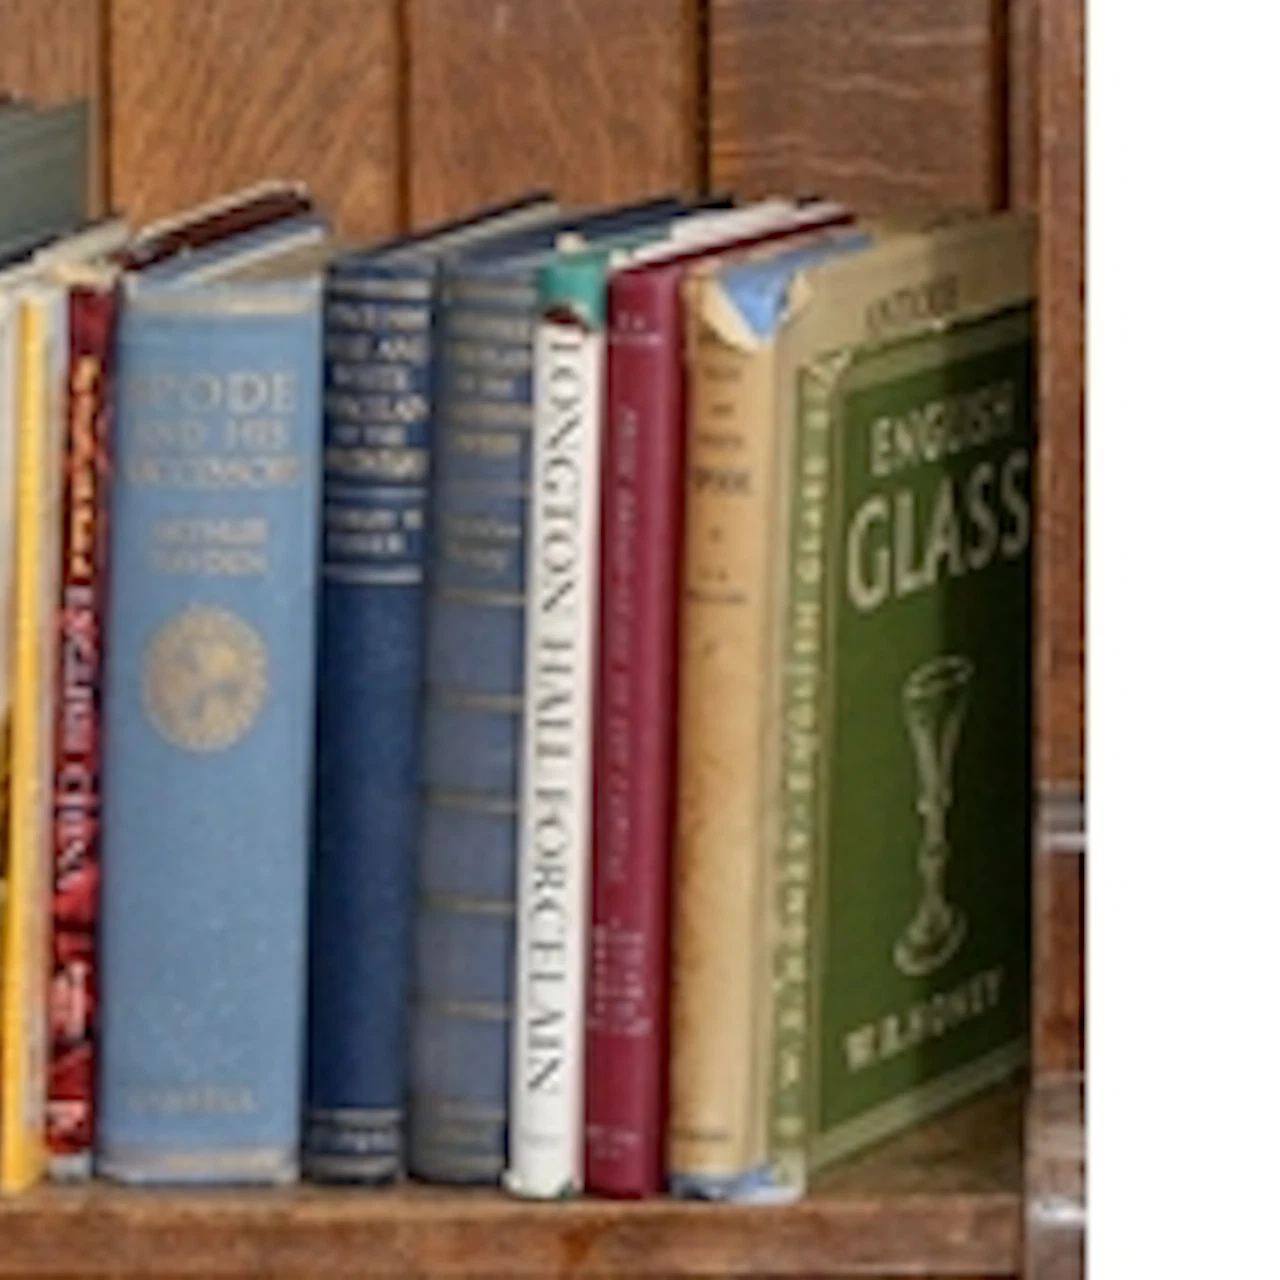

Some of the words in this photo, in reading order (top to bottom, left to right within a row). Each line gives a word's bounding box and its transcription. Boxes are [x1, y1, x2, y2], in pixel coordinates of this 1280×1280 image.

[127, 371, 300, 414] SPODE
[138, 421, 202, 449] AND
[228, 420, 291, 449] HIS
[870, 381, 1017, 476] ENGLISH
[542, 338, 584, 615] LONGTON
[795, 453, 826, 578] GLASS
[845, 453, 1030, 612] GLASS
[60, 585, 96, 756] ENGLISH
[535, 637, 576, 761] HALL
[785, 600, 822, 794] ENGLISH
[54, 764, 94, 894] CHINA
[526, 782, 573, 1096] PORCELAIN
